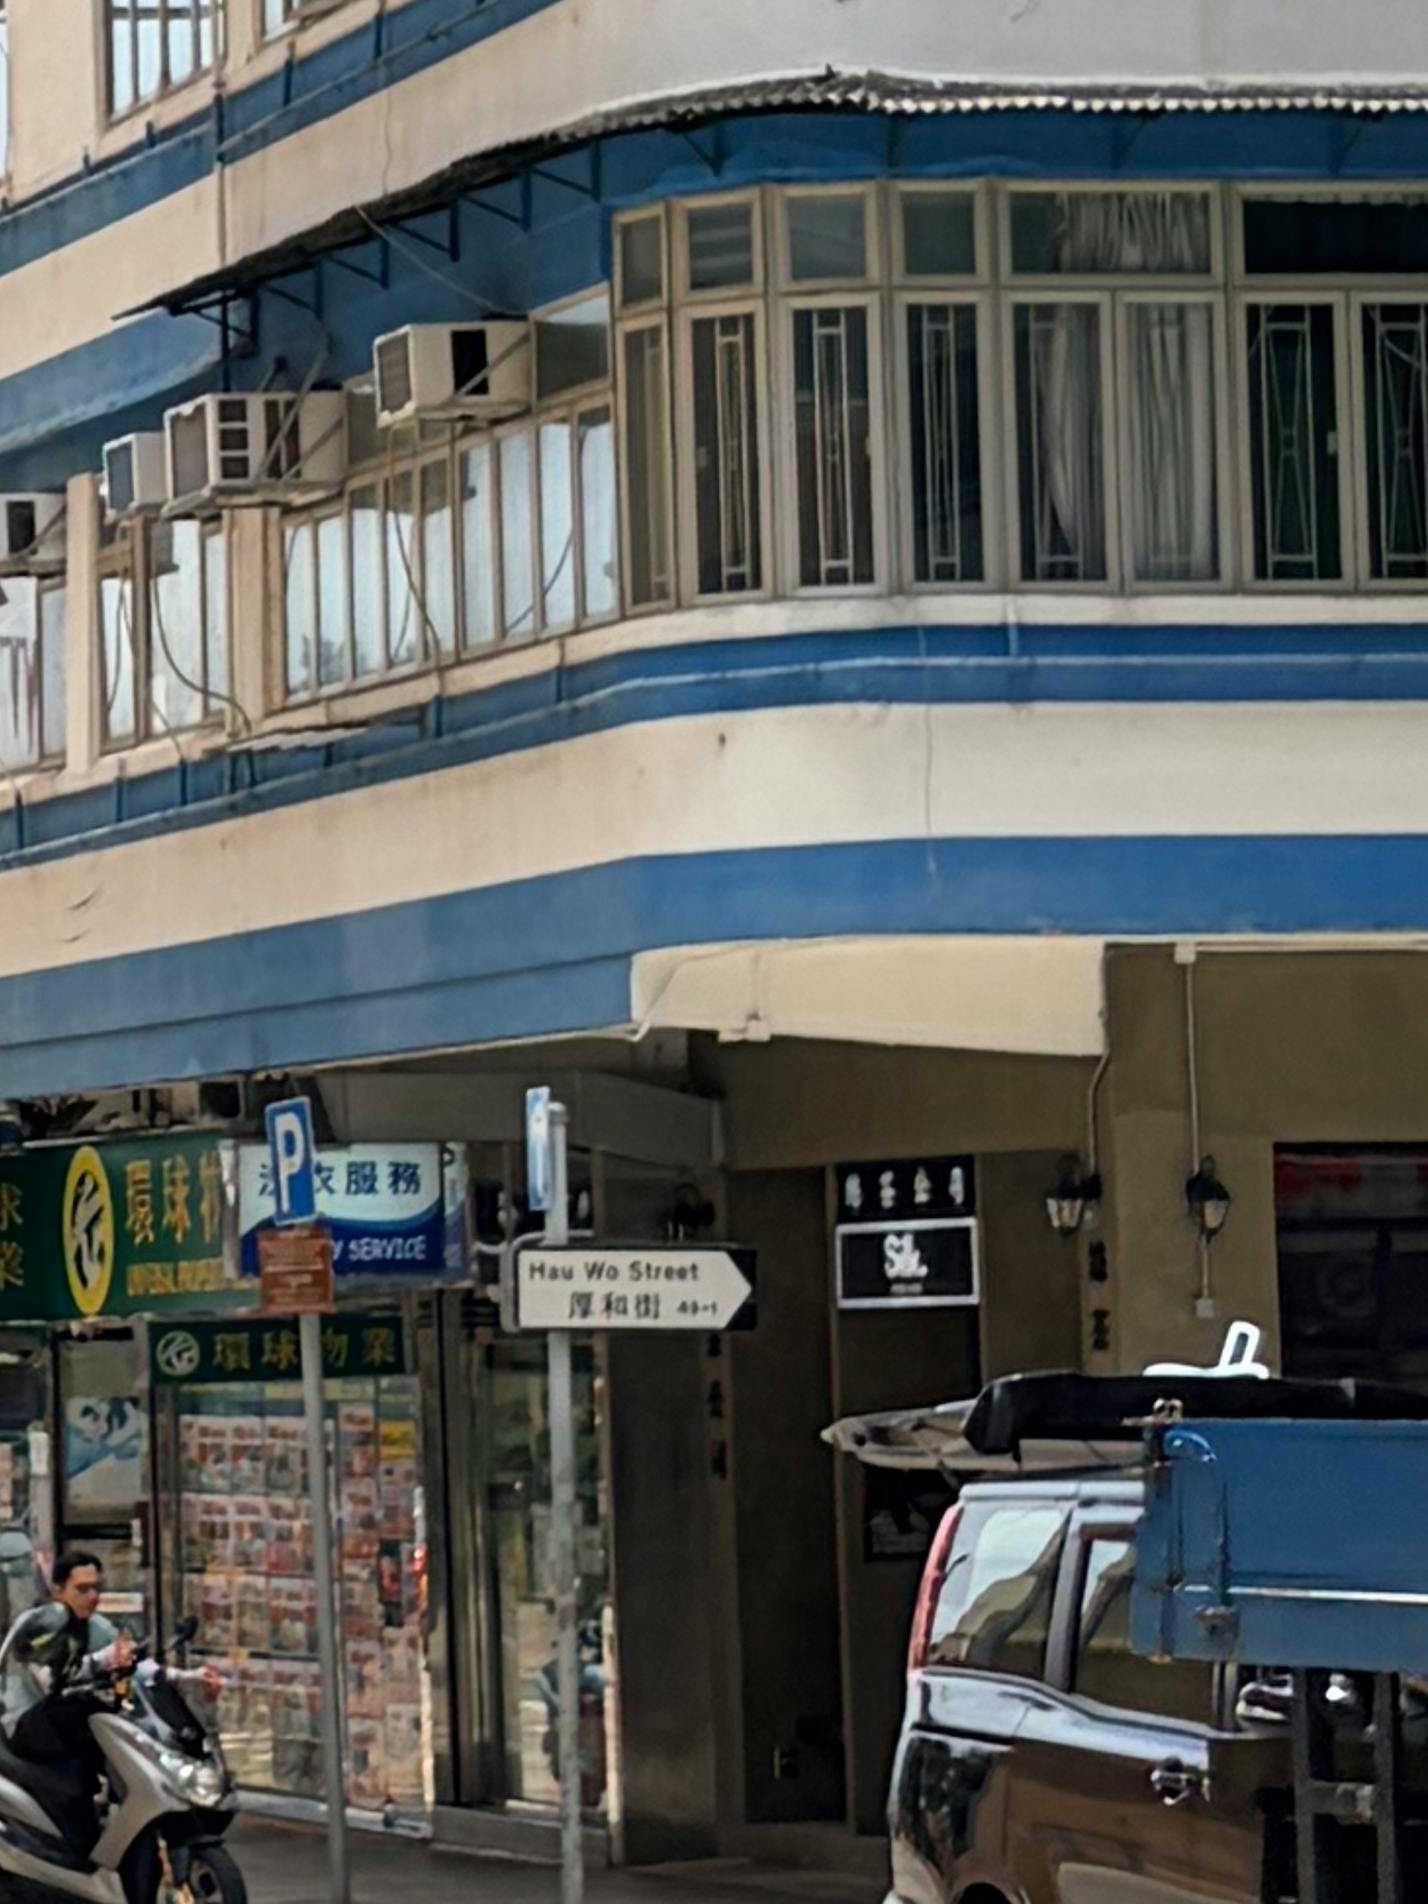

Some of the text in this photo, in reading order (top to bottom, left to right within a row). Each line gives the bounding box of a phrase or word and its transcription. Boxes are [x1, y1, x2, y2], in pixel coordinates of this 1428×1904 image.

[347, 1234, 428, 1262] SERVICE
[528, 1260, 699, 1282] Hau Wo Street
[568, 1292, 661, 1320] 厚和街
